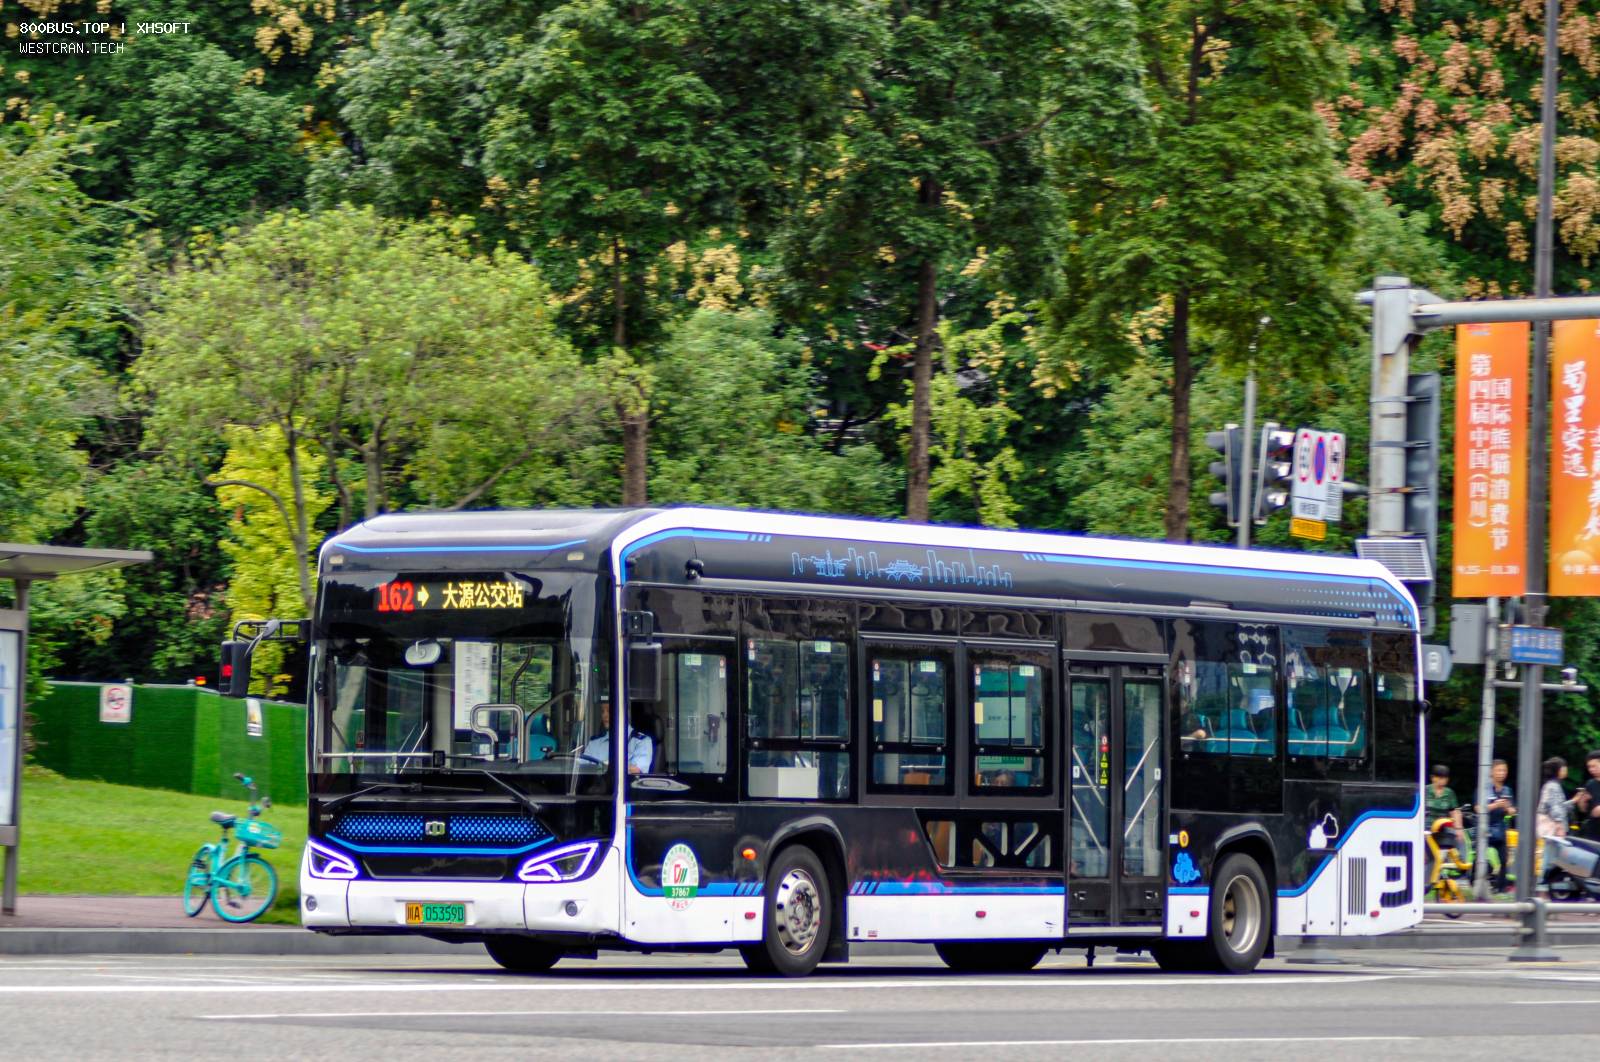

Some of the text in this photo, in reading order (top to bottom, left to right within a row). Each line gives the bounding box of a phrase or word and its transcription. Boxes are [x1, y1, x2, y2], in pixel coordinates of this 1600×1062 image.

[1489, 378, 1512, 551] 国际熊猫消费节
[378, 581, 523, 611] 162 大源公交站
